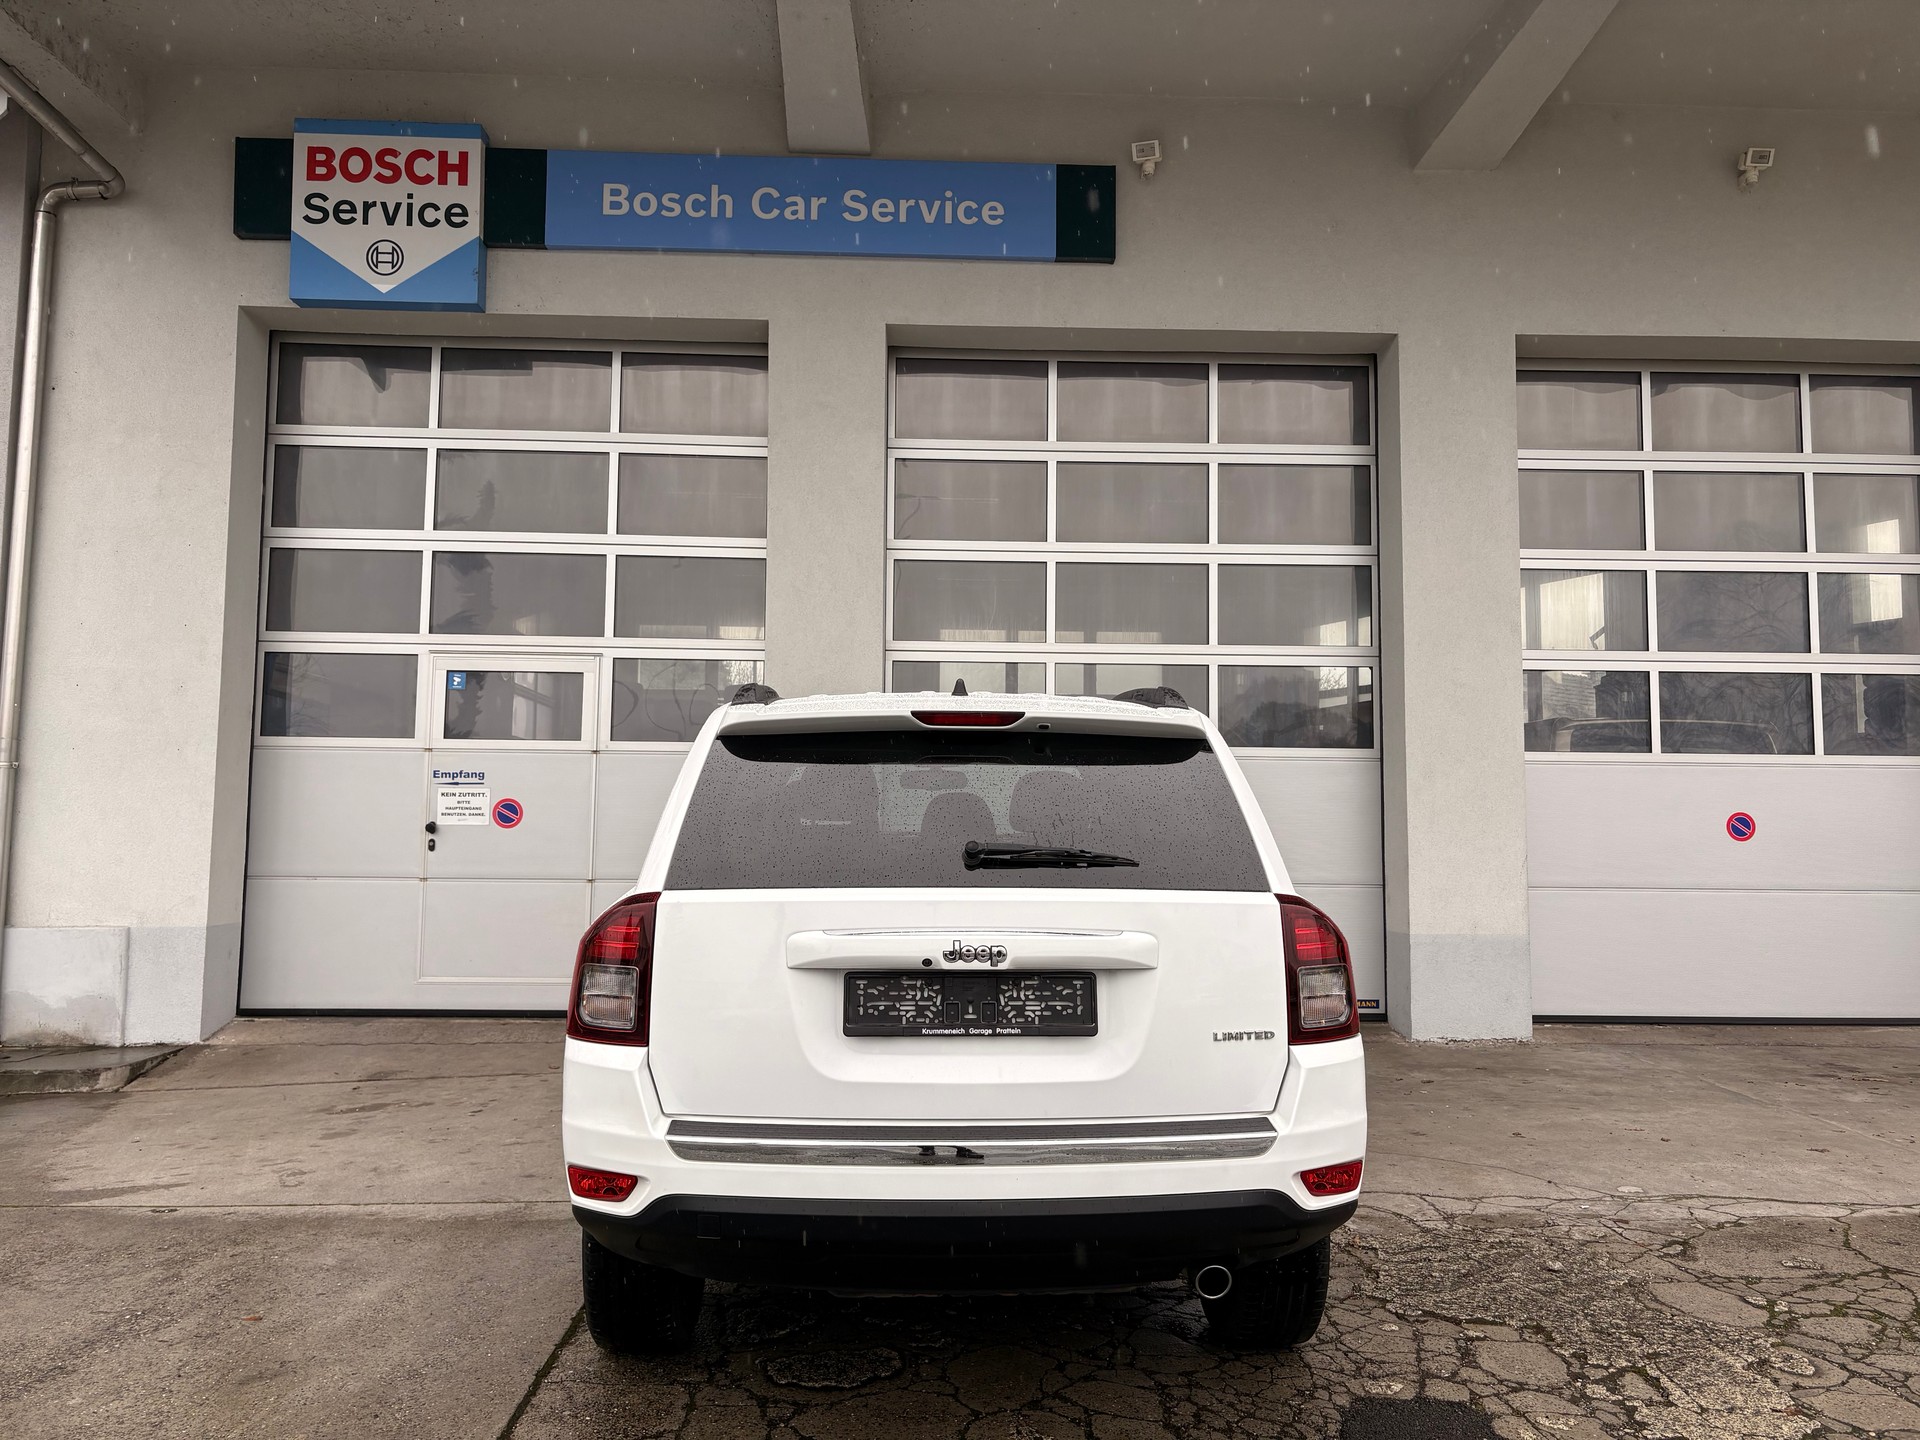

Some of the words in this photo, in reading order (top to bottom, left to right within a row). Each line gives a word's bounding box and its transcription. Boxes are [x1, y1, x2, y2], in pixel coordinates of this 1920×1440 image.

[305, 145, 469, 186] BOSCH
[302, 193, 470, 229] Service
[601, 182, 733, 219] Bosch
[751, 186, 827, 222] Car
[842, 189, 1006, 227] Service
[432, 770, 485, 780] Empfang
[943, 939, 1008, 968] Jeep
[921, 1027, 966, 1035] Krummeneich
[968, 1027, 993, 1036] Garage
[1212, 1030, 1276, 1042] LIMITED
